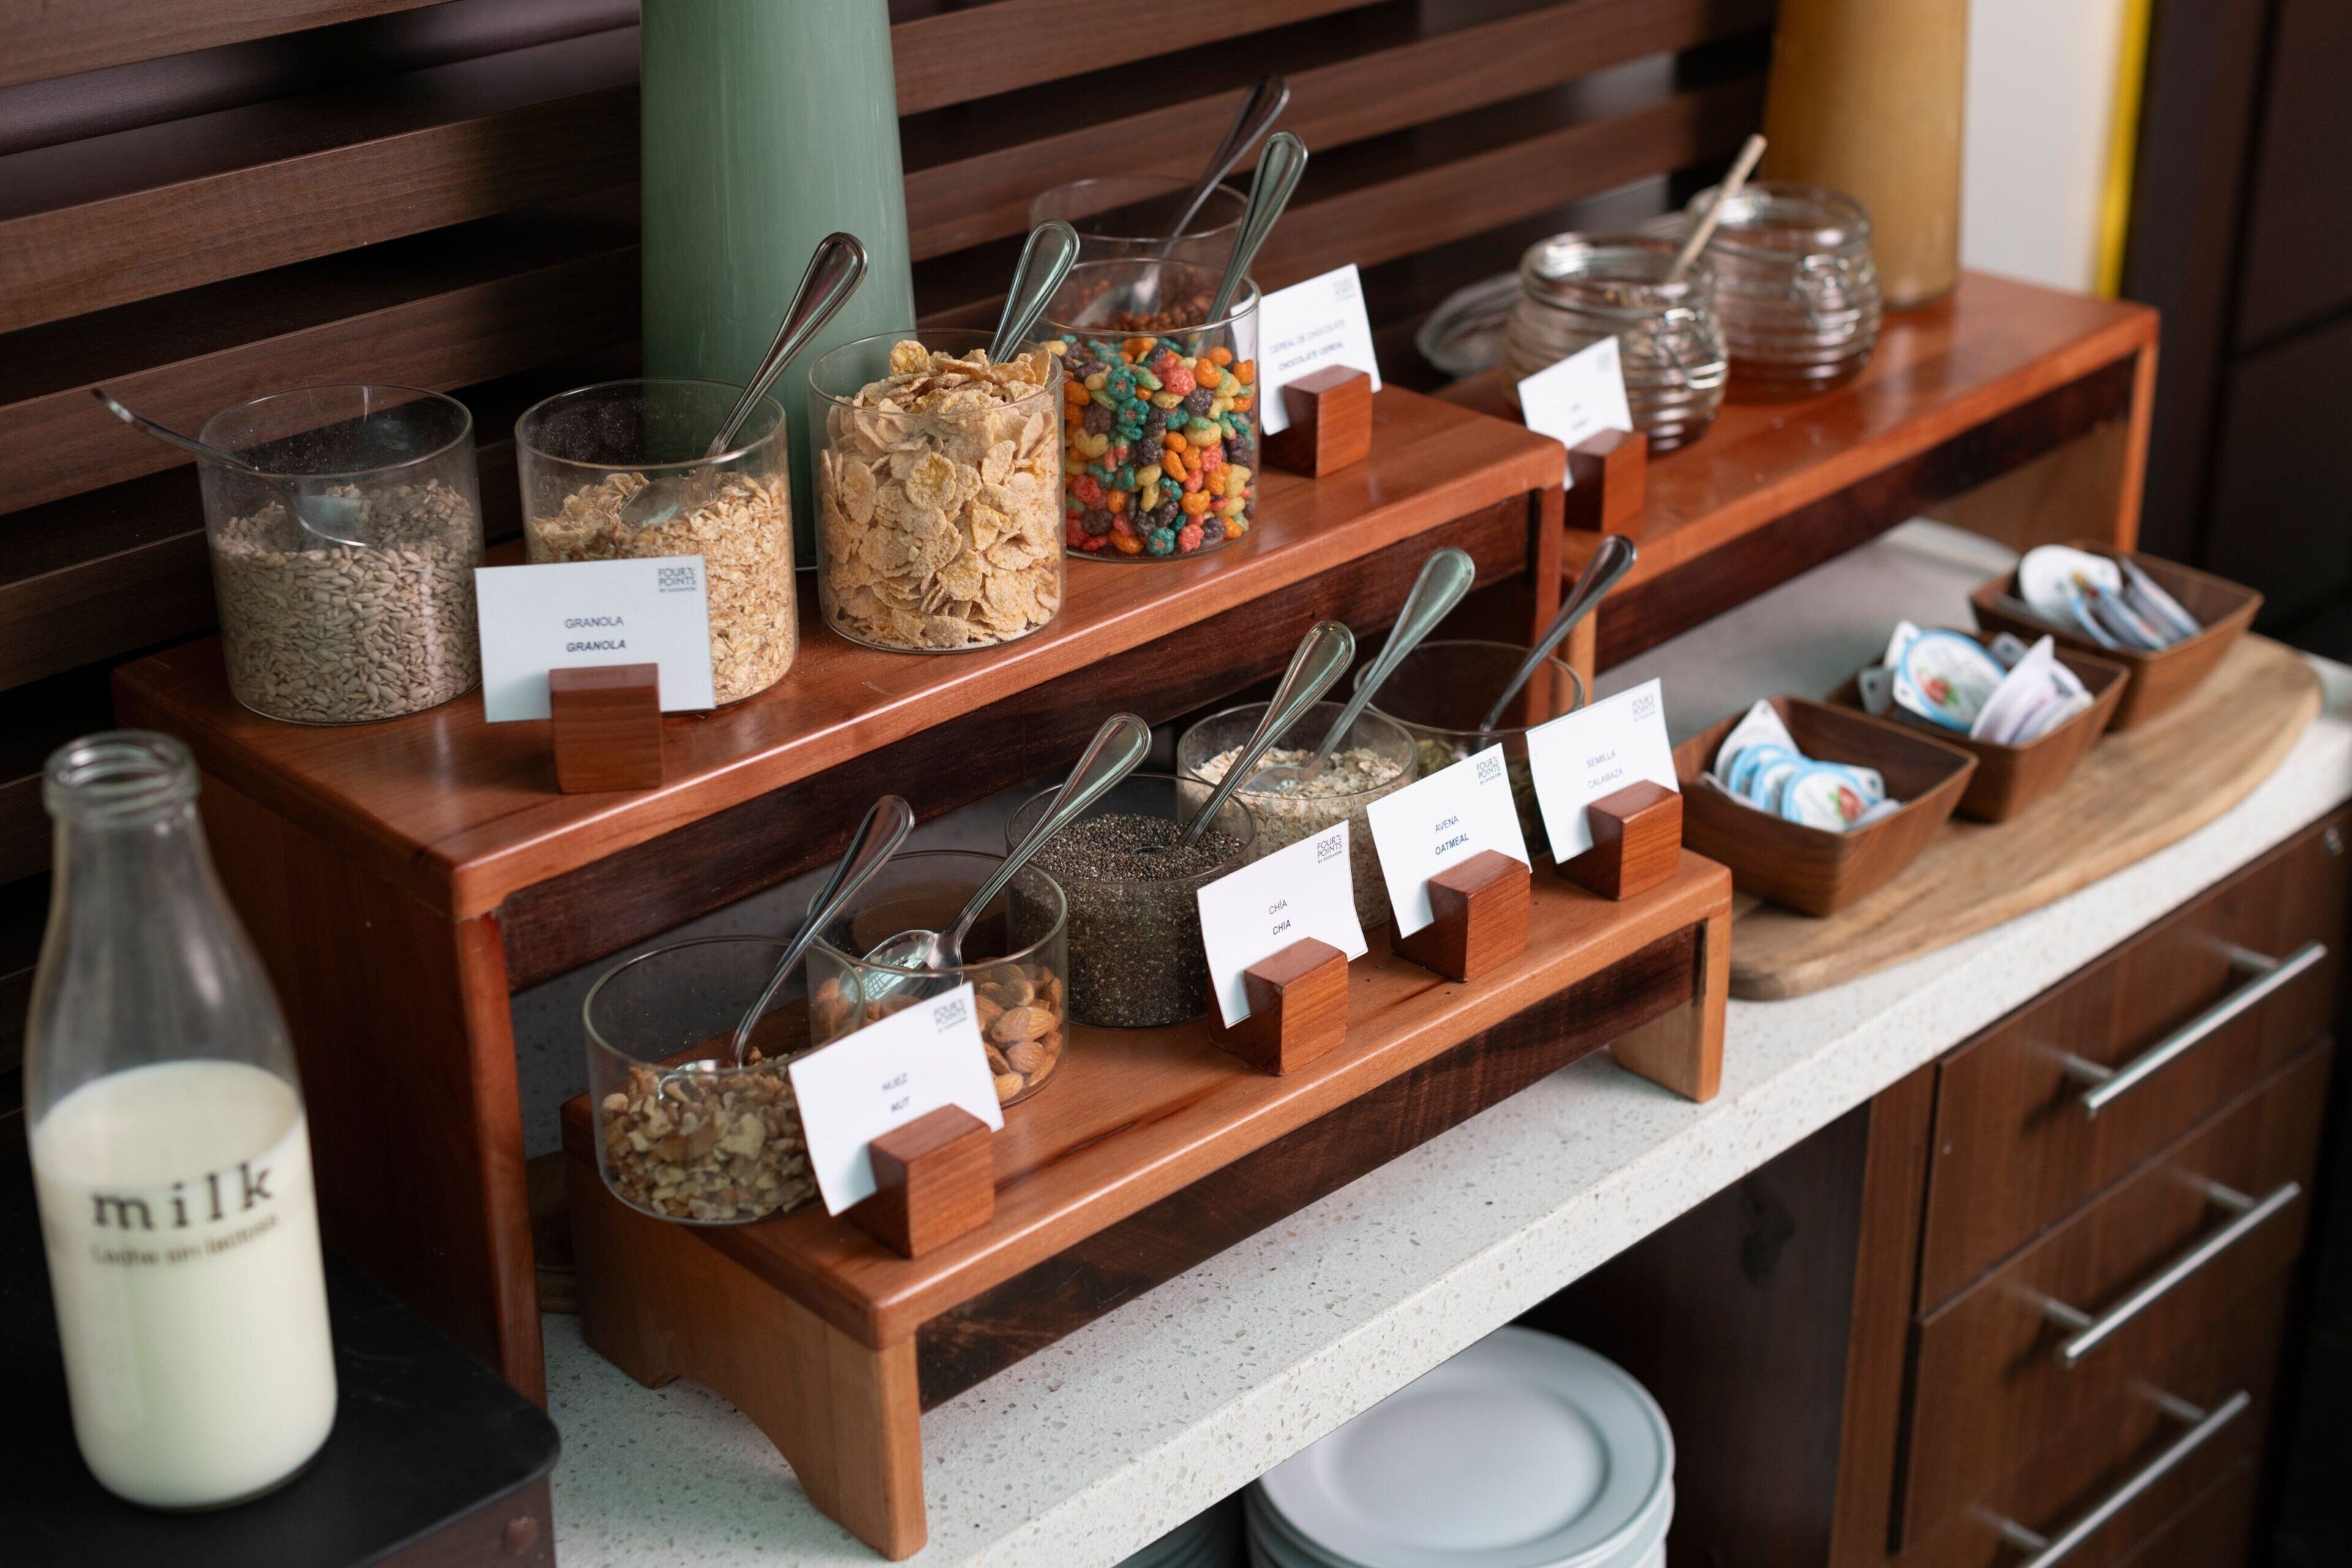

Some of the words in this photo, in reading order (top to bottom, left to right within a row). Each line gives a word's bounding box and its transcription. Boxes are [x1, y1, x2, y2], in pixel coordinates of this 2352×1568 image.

[658, 576, 696, 586] POINTS
[565, 616, 624, 628] GRANOLA
[566, 639, 627, 652] GRANOLA
[1477, 758, 1493, 772] FOUR
[1586, 750, 1616, 768] SEMILLA
[1478, 763, 1500, 779] POINTS
[1587, 768, 1624, 789] CALABAZA
[1434, 815, 1459, 833] AVENA
[1317, 836, 1336, 850] FOUR
[1317, 841, 1342, 859] POINTS
[1435, 832, 1469, 856] OATMEAL
[1268, 898, 1288, 915] CHÍA
[1273, 919, 1291, 935] CHIA
[882, 1072, 908, 1092] NUEZ
[891, 1096, 910, 1113] NUT
[91, 1161, 273, 1231] milk
